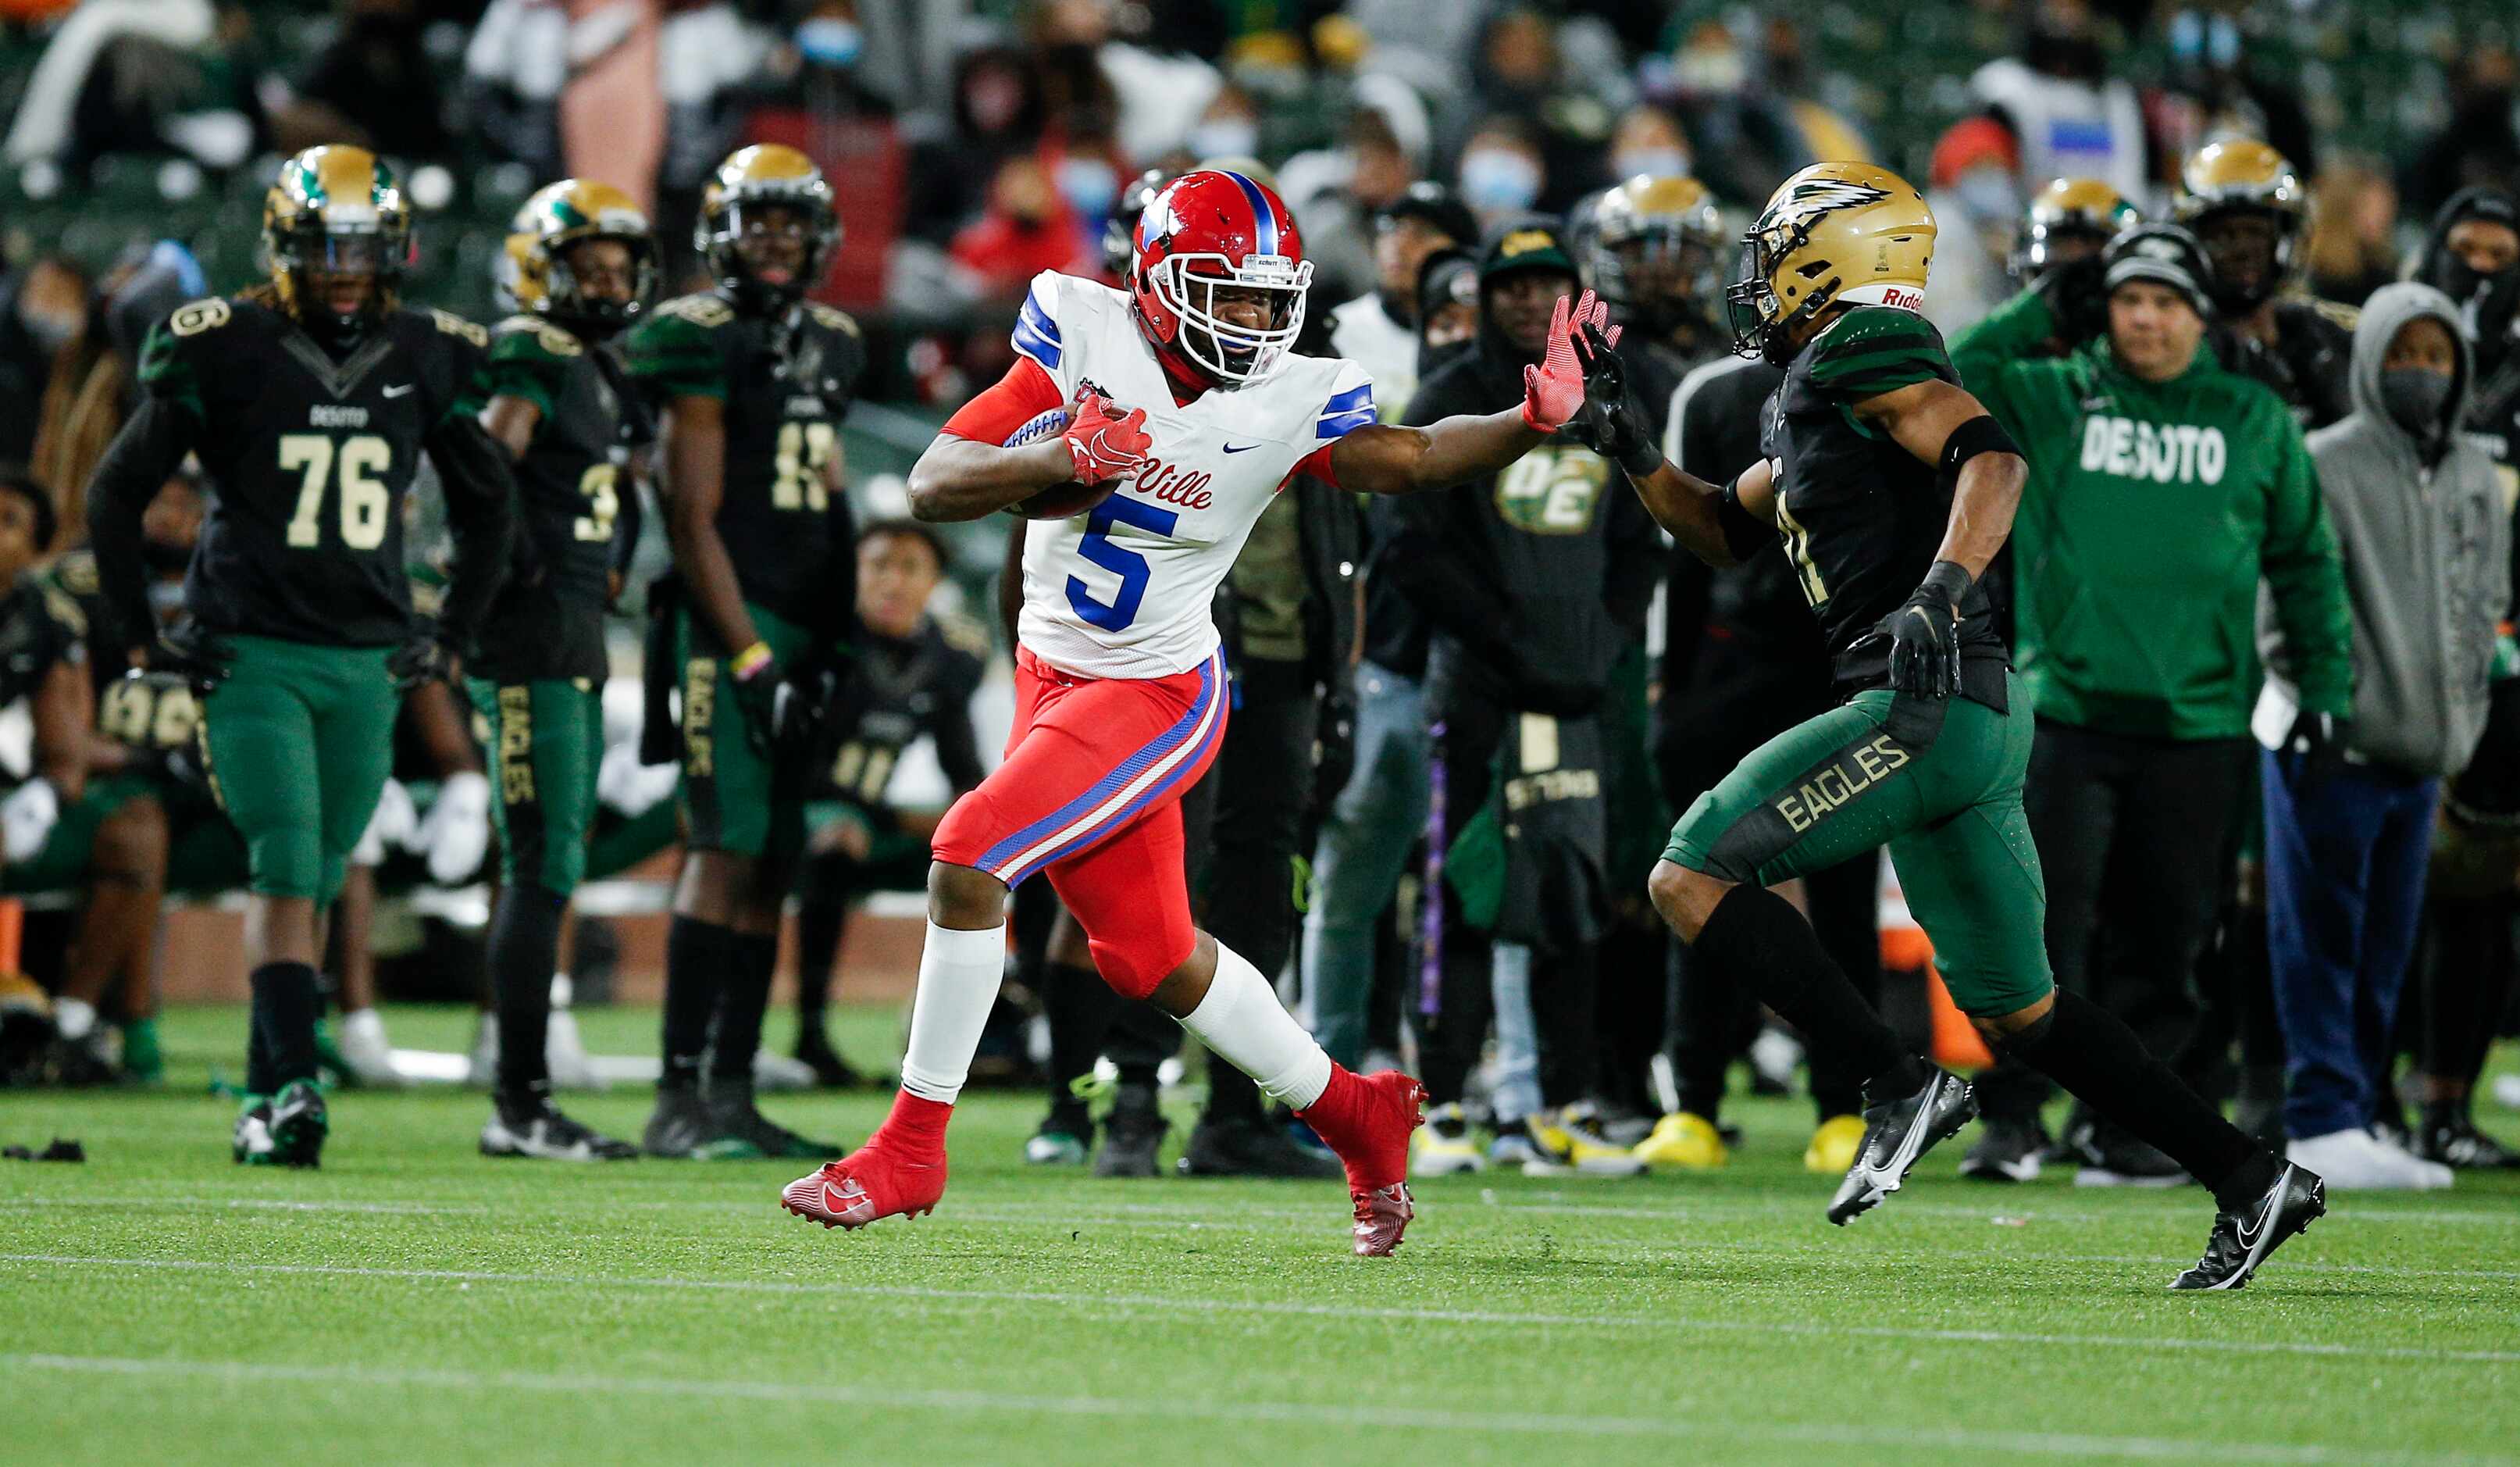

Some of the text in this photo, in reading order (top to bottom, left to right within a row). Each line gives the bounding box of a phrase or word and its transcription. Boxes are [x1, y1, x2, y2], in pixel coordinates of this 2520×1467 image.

[279, 434, 391, 550] 76
[1065, 491, 1179, 634] 5
[1777, 734, 1910, 833] EAGLES
